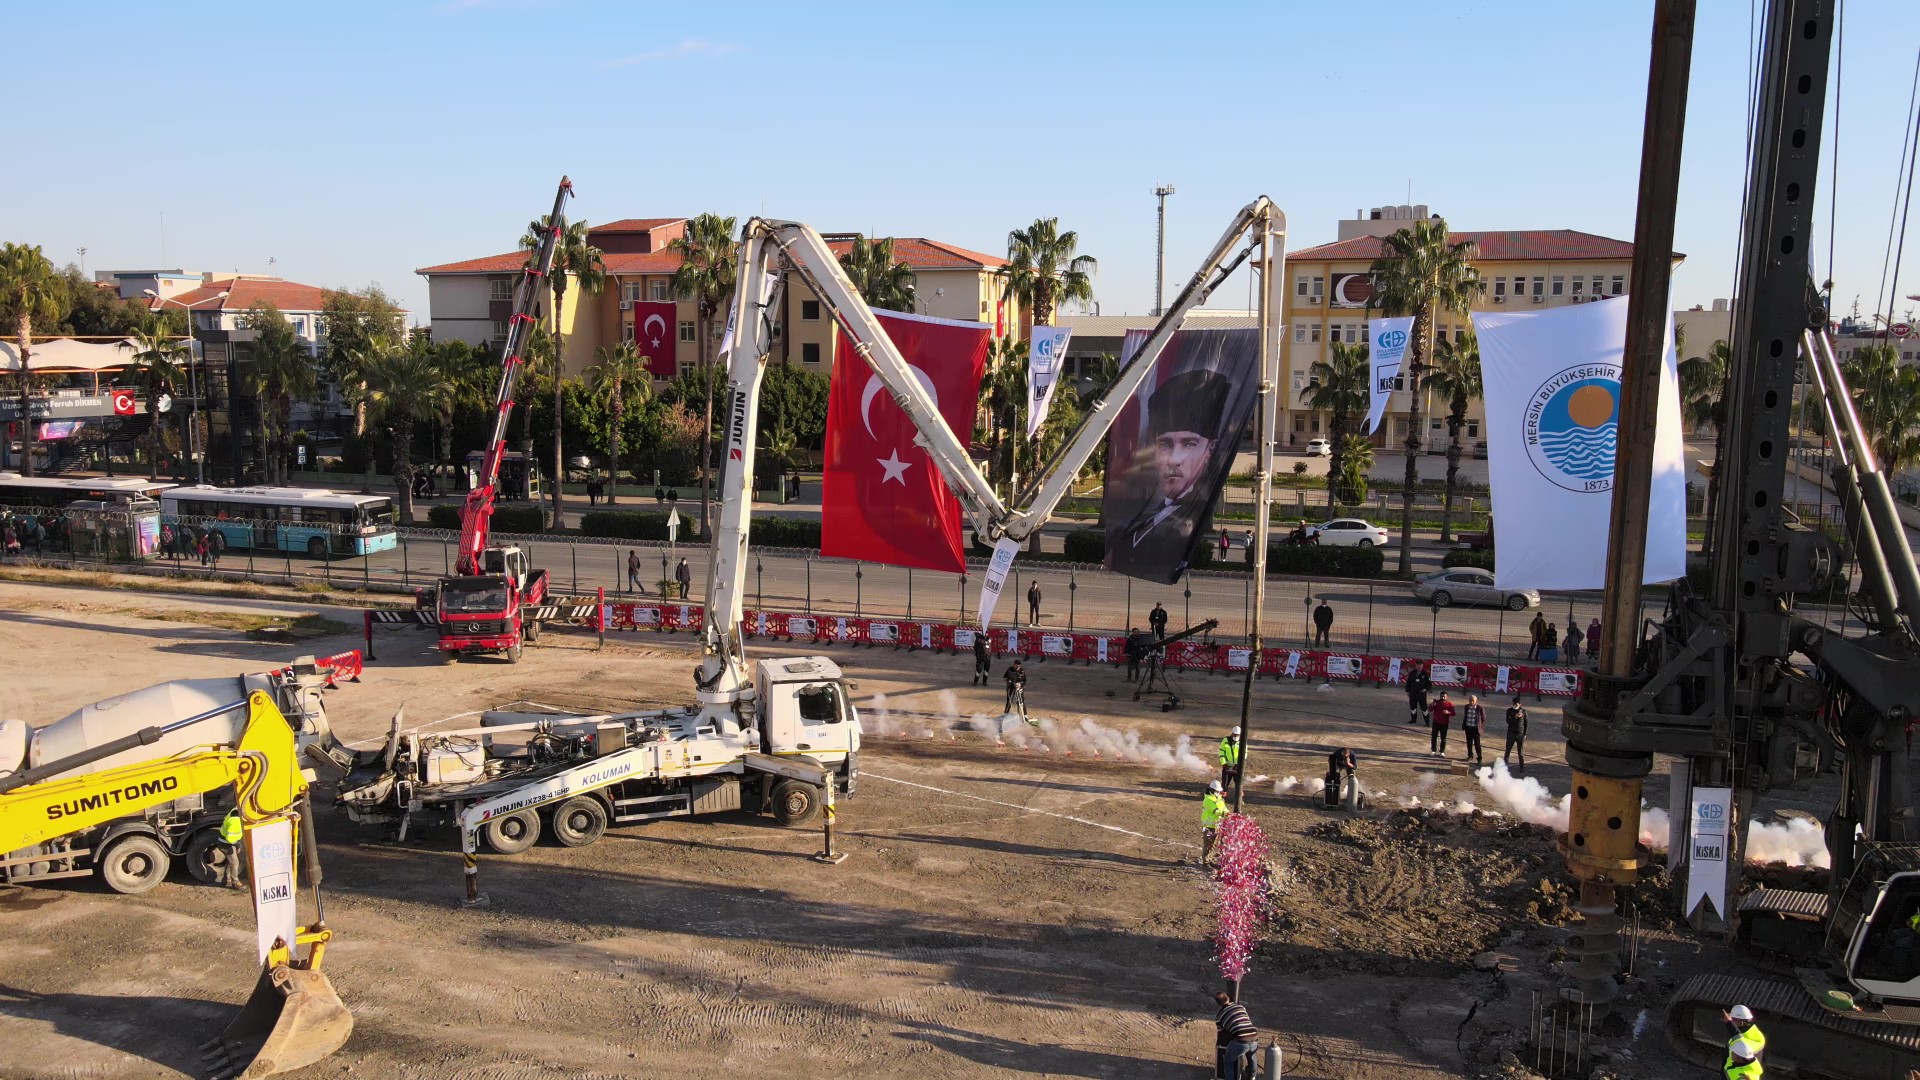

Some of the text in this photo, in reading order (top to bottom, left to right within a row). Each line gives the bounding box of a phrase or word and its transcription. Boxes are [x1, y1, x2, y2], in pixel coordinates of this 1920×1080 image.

[1380, 376, 1394, 391] KiS
[50, 400, 73, 408] Ferruh
[75, 398, 101, 407] DİKMEN
[1527, 367, 1616, 445] MERSİN BÜYÜKŞEHİR
[733, 391, 746, 445] JUNJIN
[1584, 479, 1610, 491] 1873
[582, 763, 631, 786] KOLUMAN
[47, 775, 178, 820] SUMITOMO
[492, 801, 523, 816] JUNJIN
